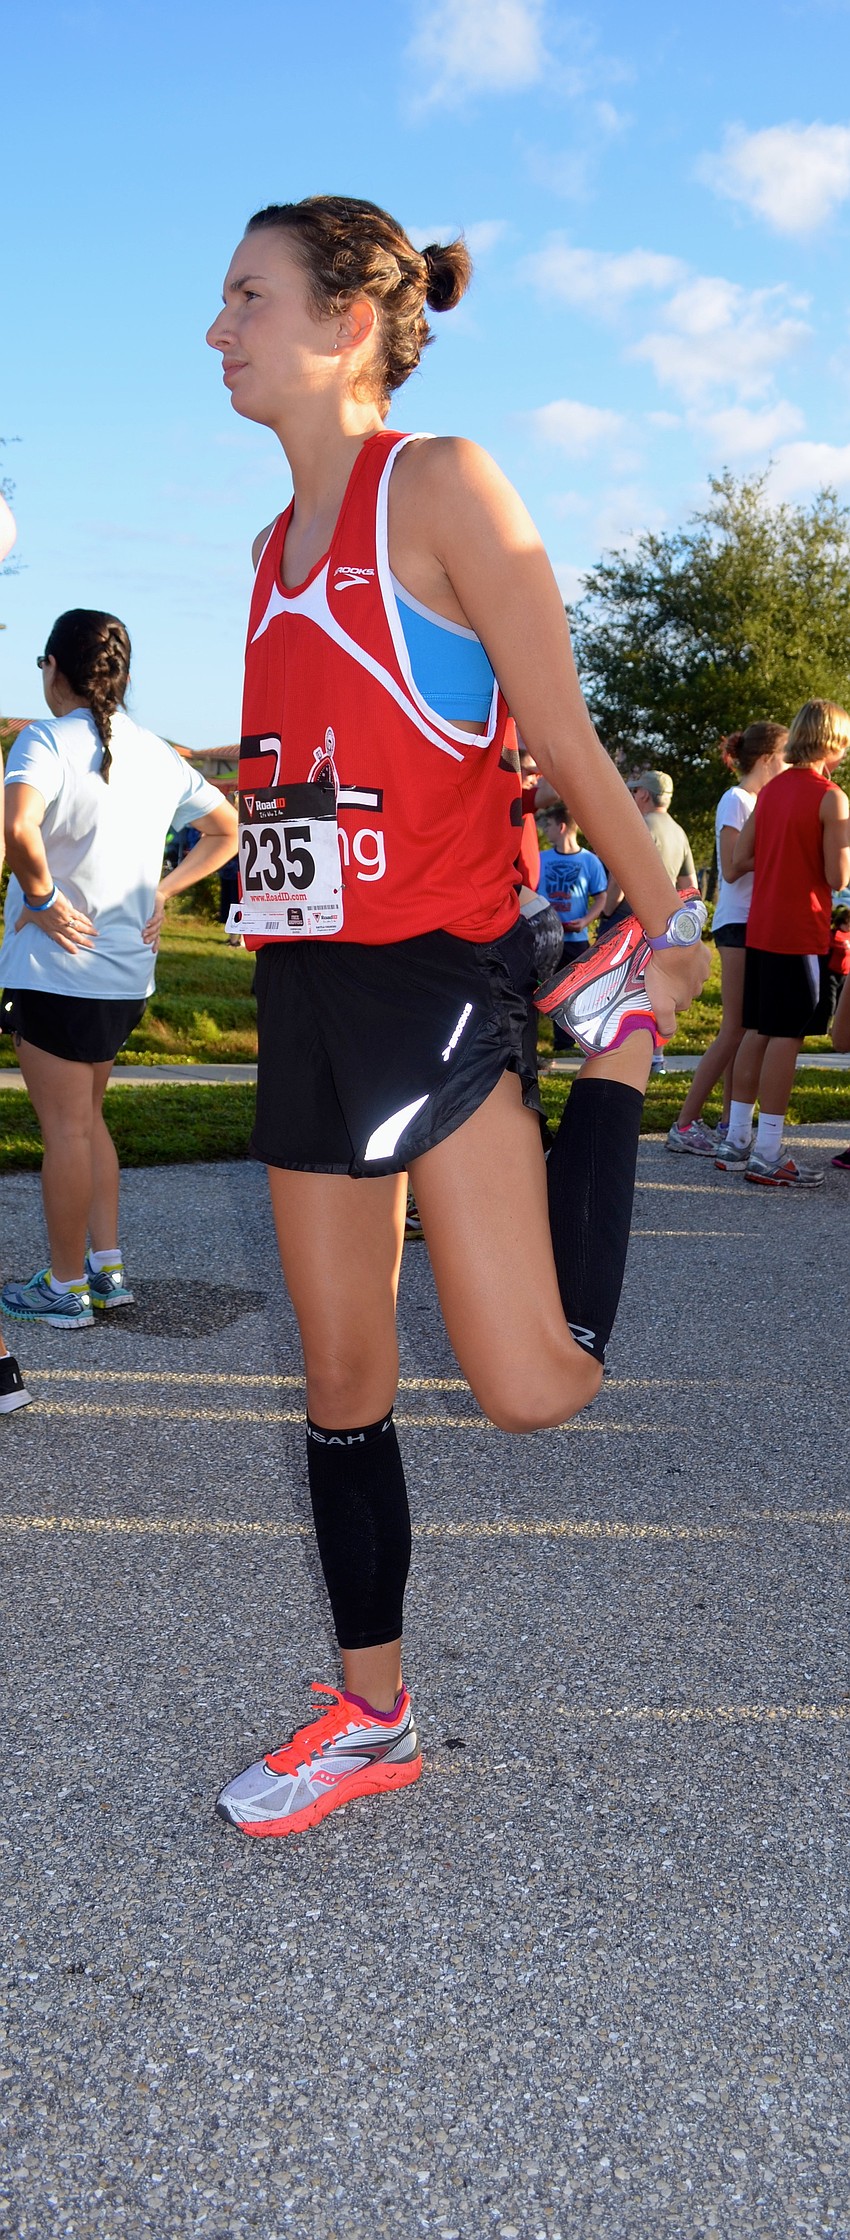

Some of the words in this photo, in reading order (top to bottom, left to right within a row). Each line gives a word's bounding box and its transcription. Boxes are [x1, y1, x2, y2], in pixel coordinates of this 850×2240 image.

[255, 797, 286, 811] RoadID
[242, 826, 315, 891] 235
[250, 892, 308, 902] www.RoadID.com
